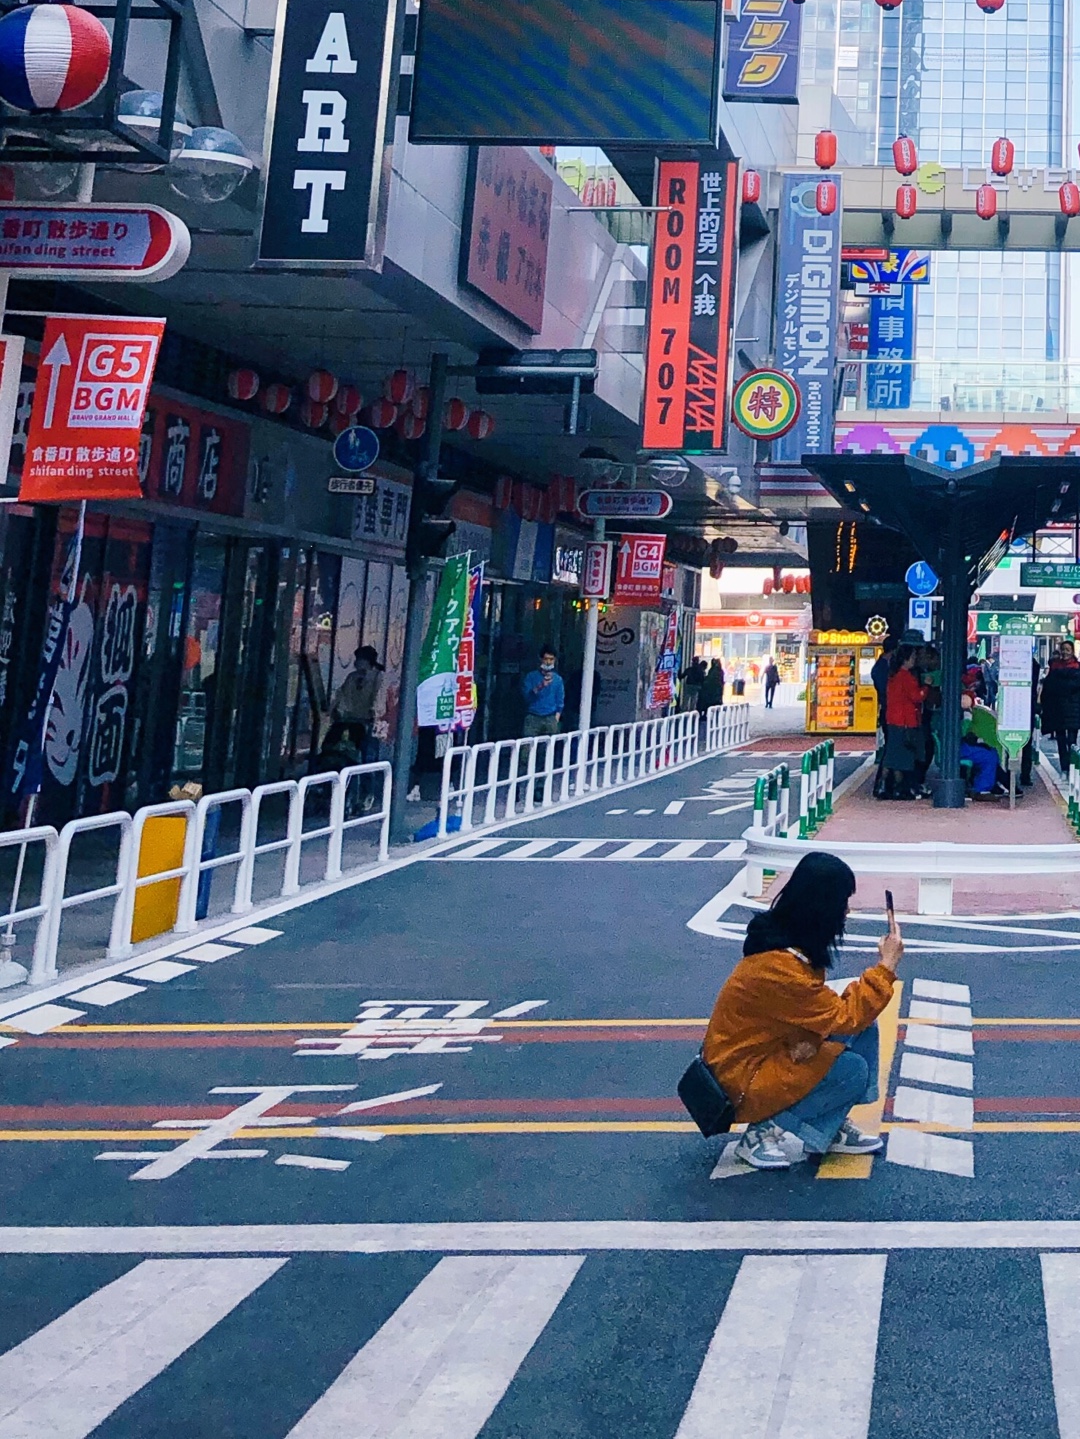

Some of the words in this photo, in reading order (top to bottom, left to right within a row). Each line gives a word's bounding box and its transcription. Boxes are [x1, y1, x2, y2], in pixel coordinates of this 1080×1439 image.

[48, 220, 129, 241] 散歩通り
[662, 178, 687, 305] ROOM
[72, 245, 116, 257] street
[694, 172, 722, 316] 世上的另一个我
[799, 229, 833, 377] DIGIMON
[87, 345, 141, 378] G5
[656, 328, 677, 425] 707
[73, 387, 141, 411] BGM
[747, 385, 783, 423] 特
[32, 446, 73, 462] 食番町
[77, 446, 135, 463] 散歩通り
[30, 466, 66, 476] shifan
[67, 466, 93, 479] ding
[98, 466, 134, 477] street
[637, 545, 658, 558] G4
[633, 561, 659, 571] BGM
[829, 633, 868, 643] Station
